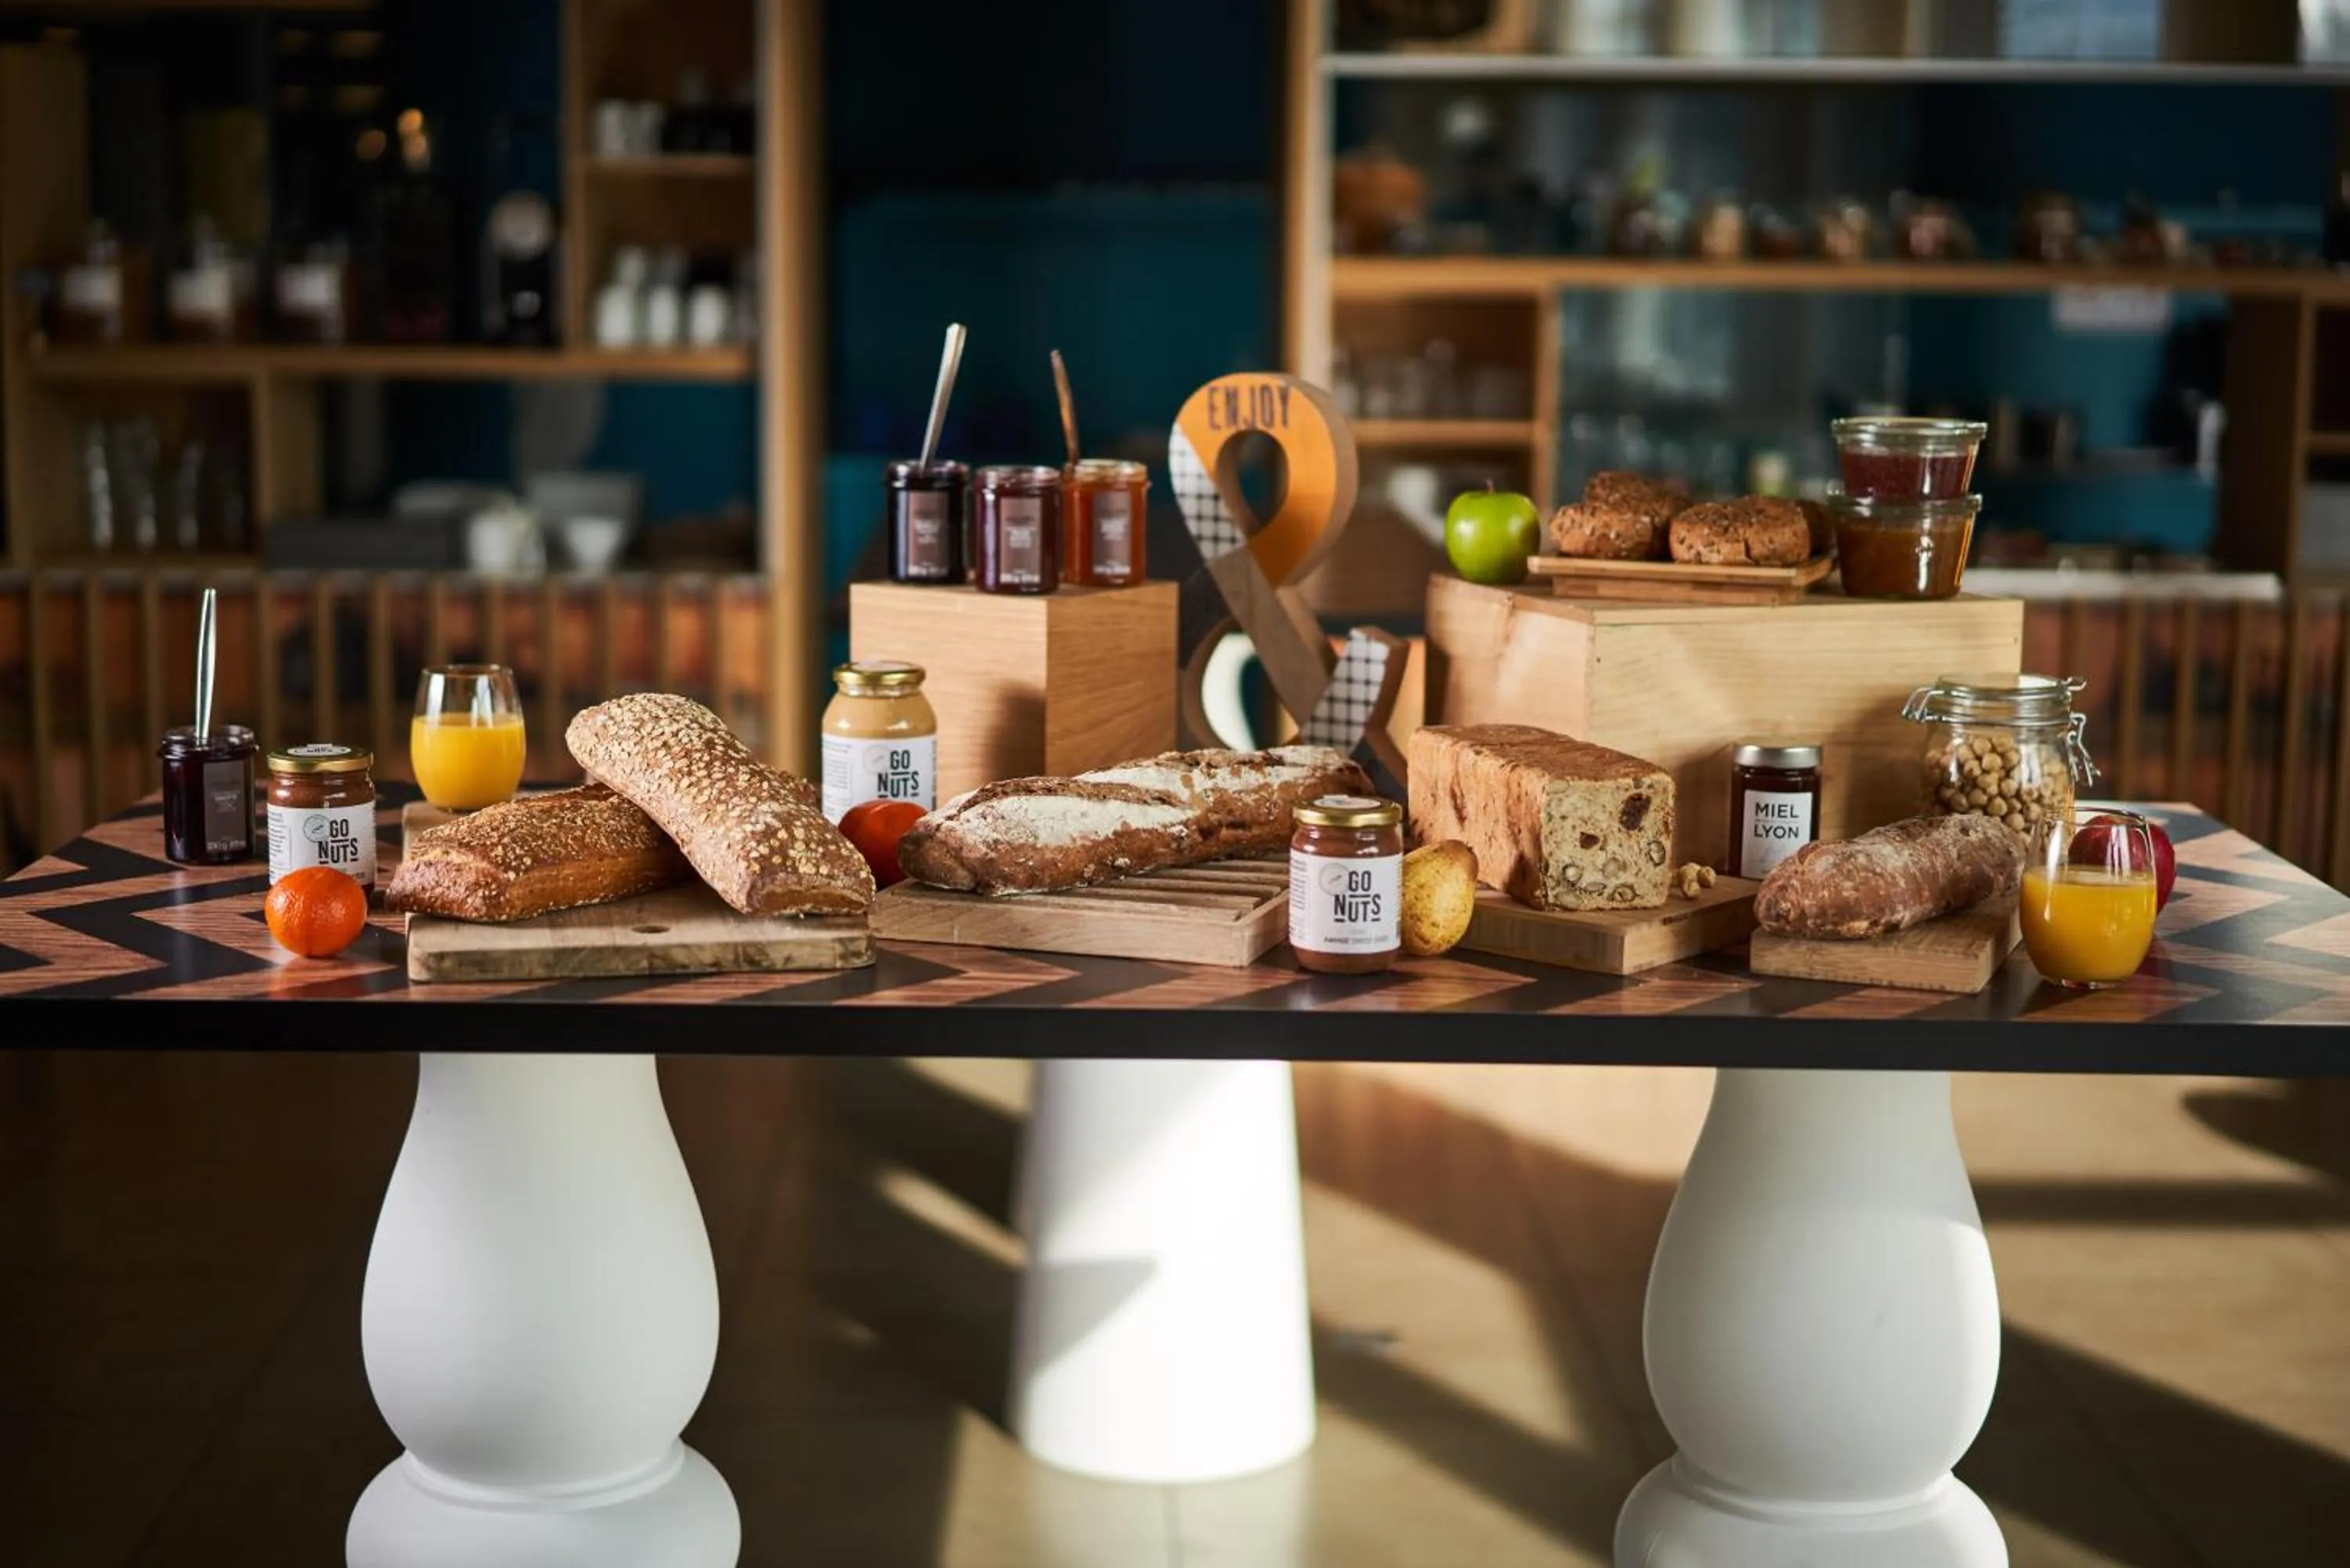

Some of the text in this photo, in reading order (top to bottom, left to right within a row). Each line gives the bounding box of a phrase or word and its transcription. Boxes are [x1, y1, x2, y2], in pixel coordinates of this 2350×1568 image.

[1207, 383, 1291, 430] ENJOY
[890, 750, 910, 770] GO
[877, 771, 919, 798] NUTS
[1755, 802, 1799, 818] MIEL
[330, 818, 349, 838] GO
[1754, 824, 1799, 839] LYON
[318, 838, 358, 864] NUTS
[1348, 870, 1372, 891] GO
[1334, 894, 1381, 923] NUTS
